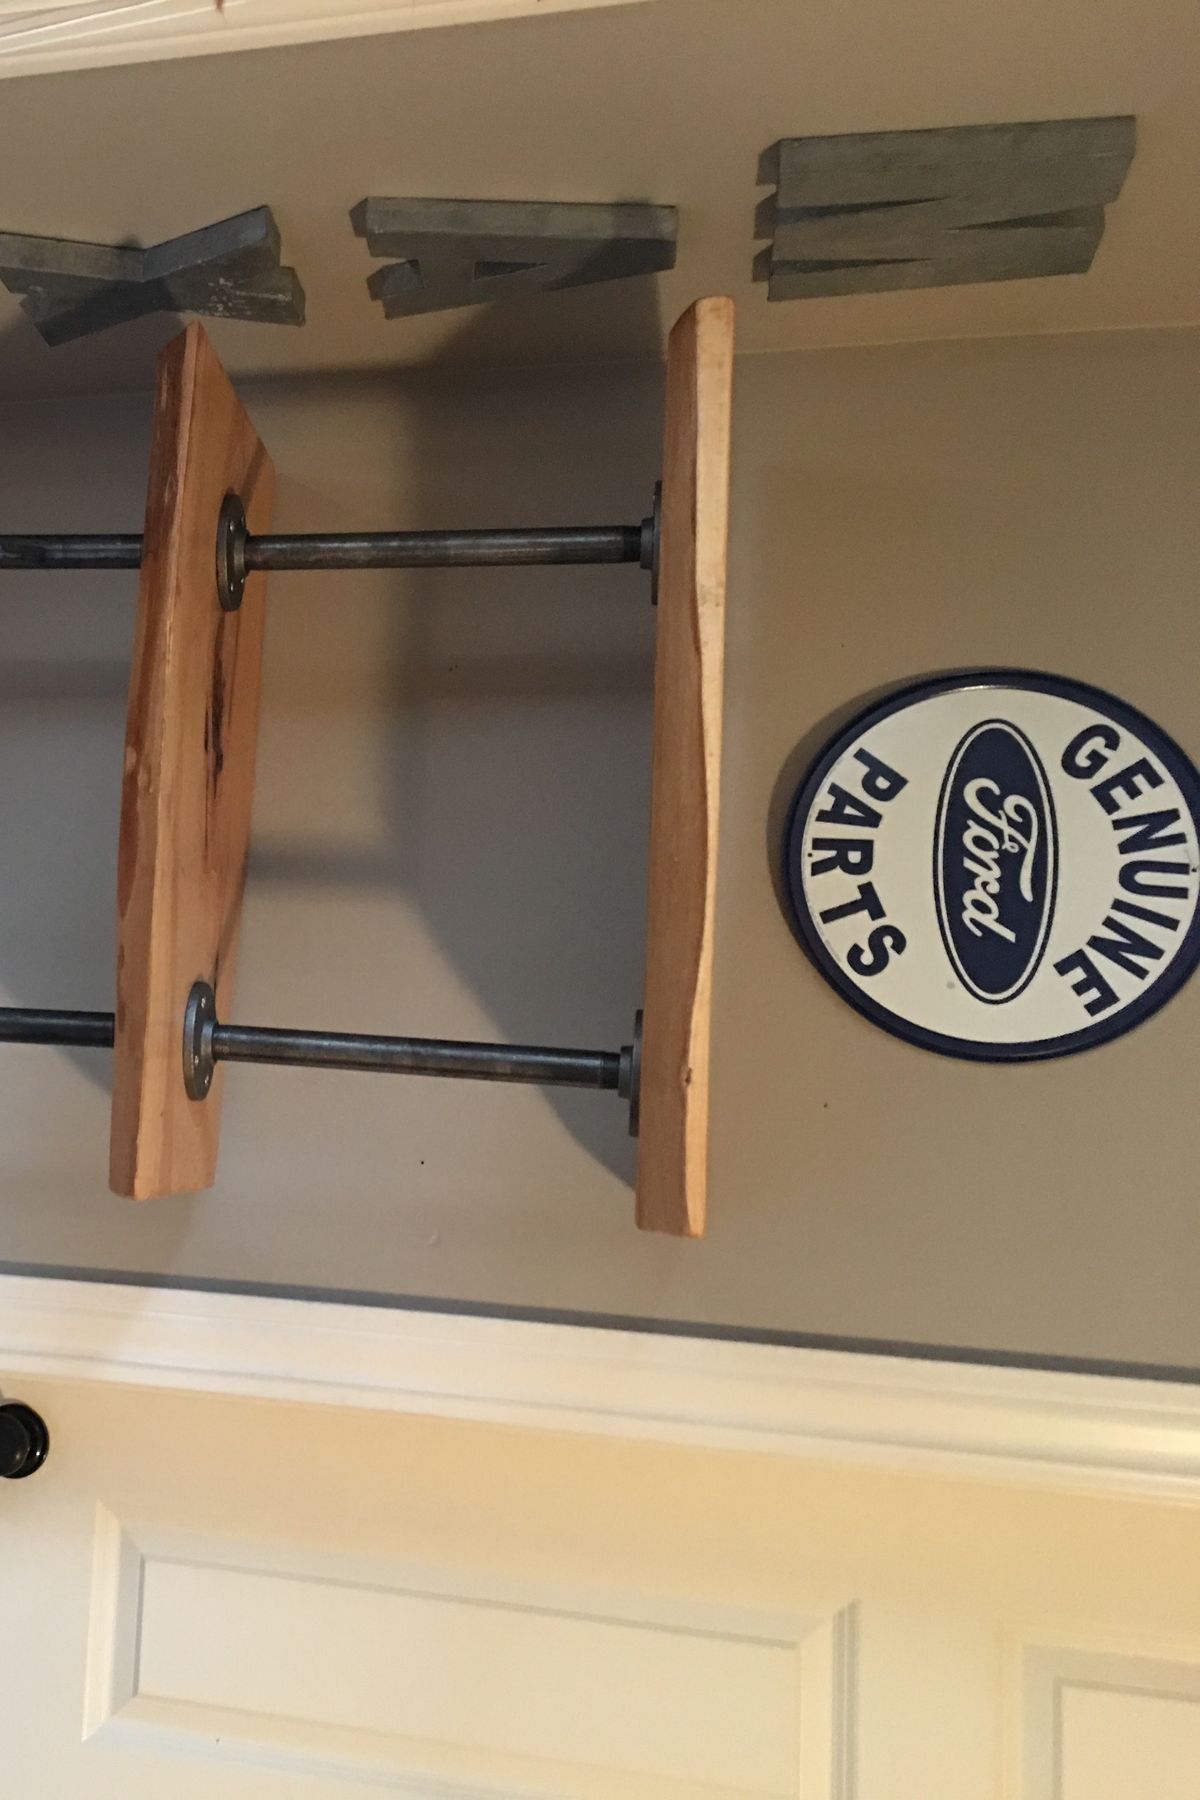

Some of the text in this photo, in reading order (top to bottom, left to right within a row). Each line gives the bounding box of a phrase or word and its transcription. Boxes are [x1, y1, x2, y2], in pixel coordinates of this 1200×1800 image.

[811, 747, 909, 977] PARTS
[963, 778, 1038, 943] Ford
[1054, 724, 1189, 1017] GENUINE
